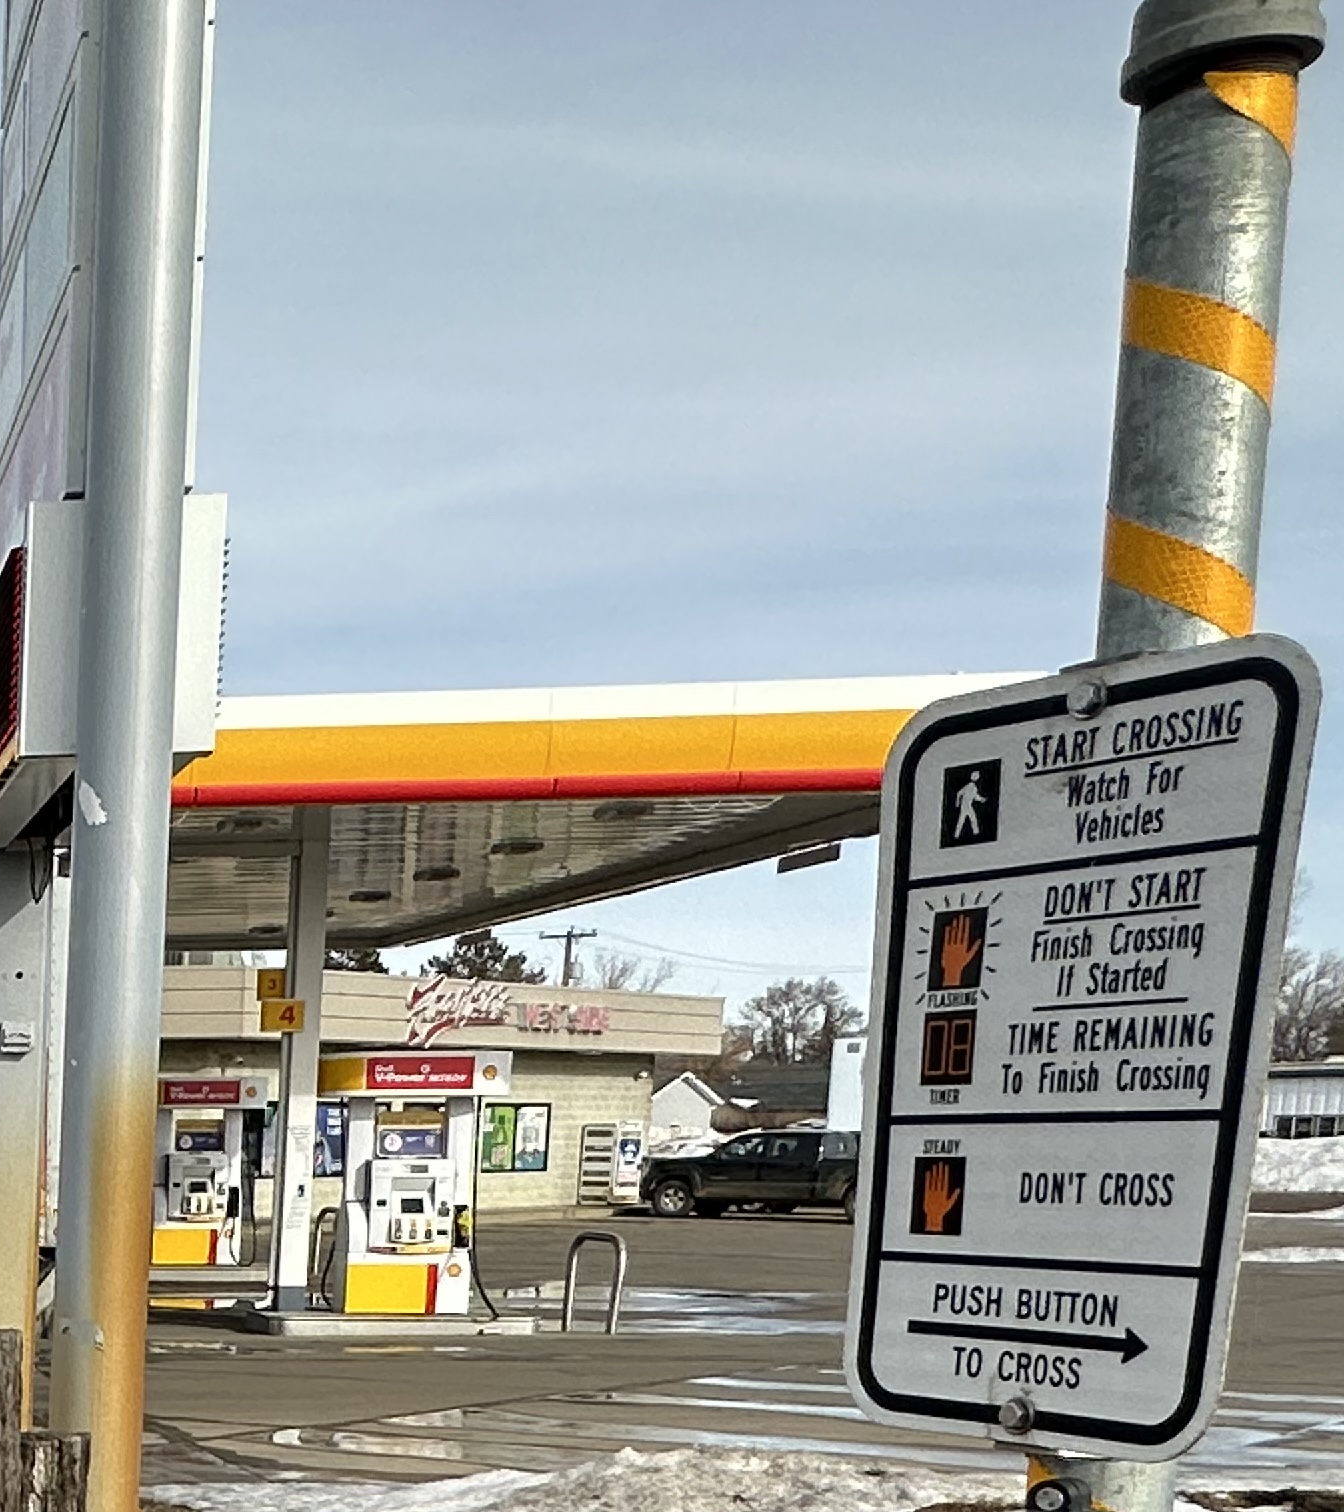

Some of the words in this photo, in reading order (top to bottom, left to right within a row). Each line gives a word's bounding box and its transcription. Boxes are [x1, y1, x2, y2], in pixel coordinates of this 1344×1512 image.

[1025, 726, 1100, 770] START
[1112, 699, 1245, 754] CROSSING
[1065, 768, 1130, 808] Watch
[1146, 760, 1185, 796] For
[1075, 806, 1165, 845] Vehicles
[1044, 878, 1116, 918] DON'T
[1128, 866, 1208, 908] START
[1030, 927, 1093, 963] Finish
[1109, 917, 1205, 958] Crossing
[927, 990, 979, 1009] FLASHING
[1056, 965, 1075, 998] If
[1086, 958, 1169, 996] Started
[278, 1005, 296, 1025] 4
[1008, 1021, 1060, 1055] TIME
[1073, 1012, 1215, 1053] REMAINING
[929, 1087, 960, 1105] TIMER
[1002, 1063, 1023, 1095] To
[1037, 1060, 1100, 1094] Finish
[1116, 1057, 1212, 1100] Crossing
[922, 1138, 961, 1156] STEADY
[1019, 1171, 1087, 1205] DON'T
[1098, 1173, 1176, 1208] CROSS
[932, 1282, 1004, 1318] PUSH
[1015, 1288, 1119, 1327] BUTTON
[953, 1346, 983, 1378] TO
[997, 1351, 1082, 1390] CROSS
